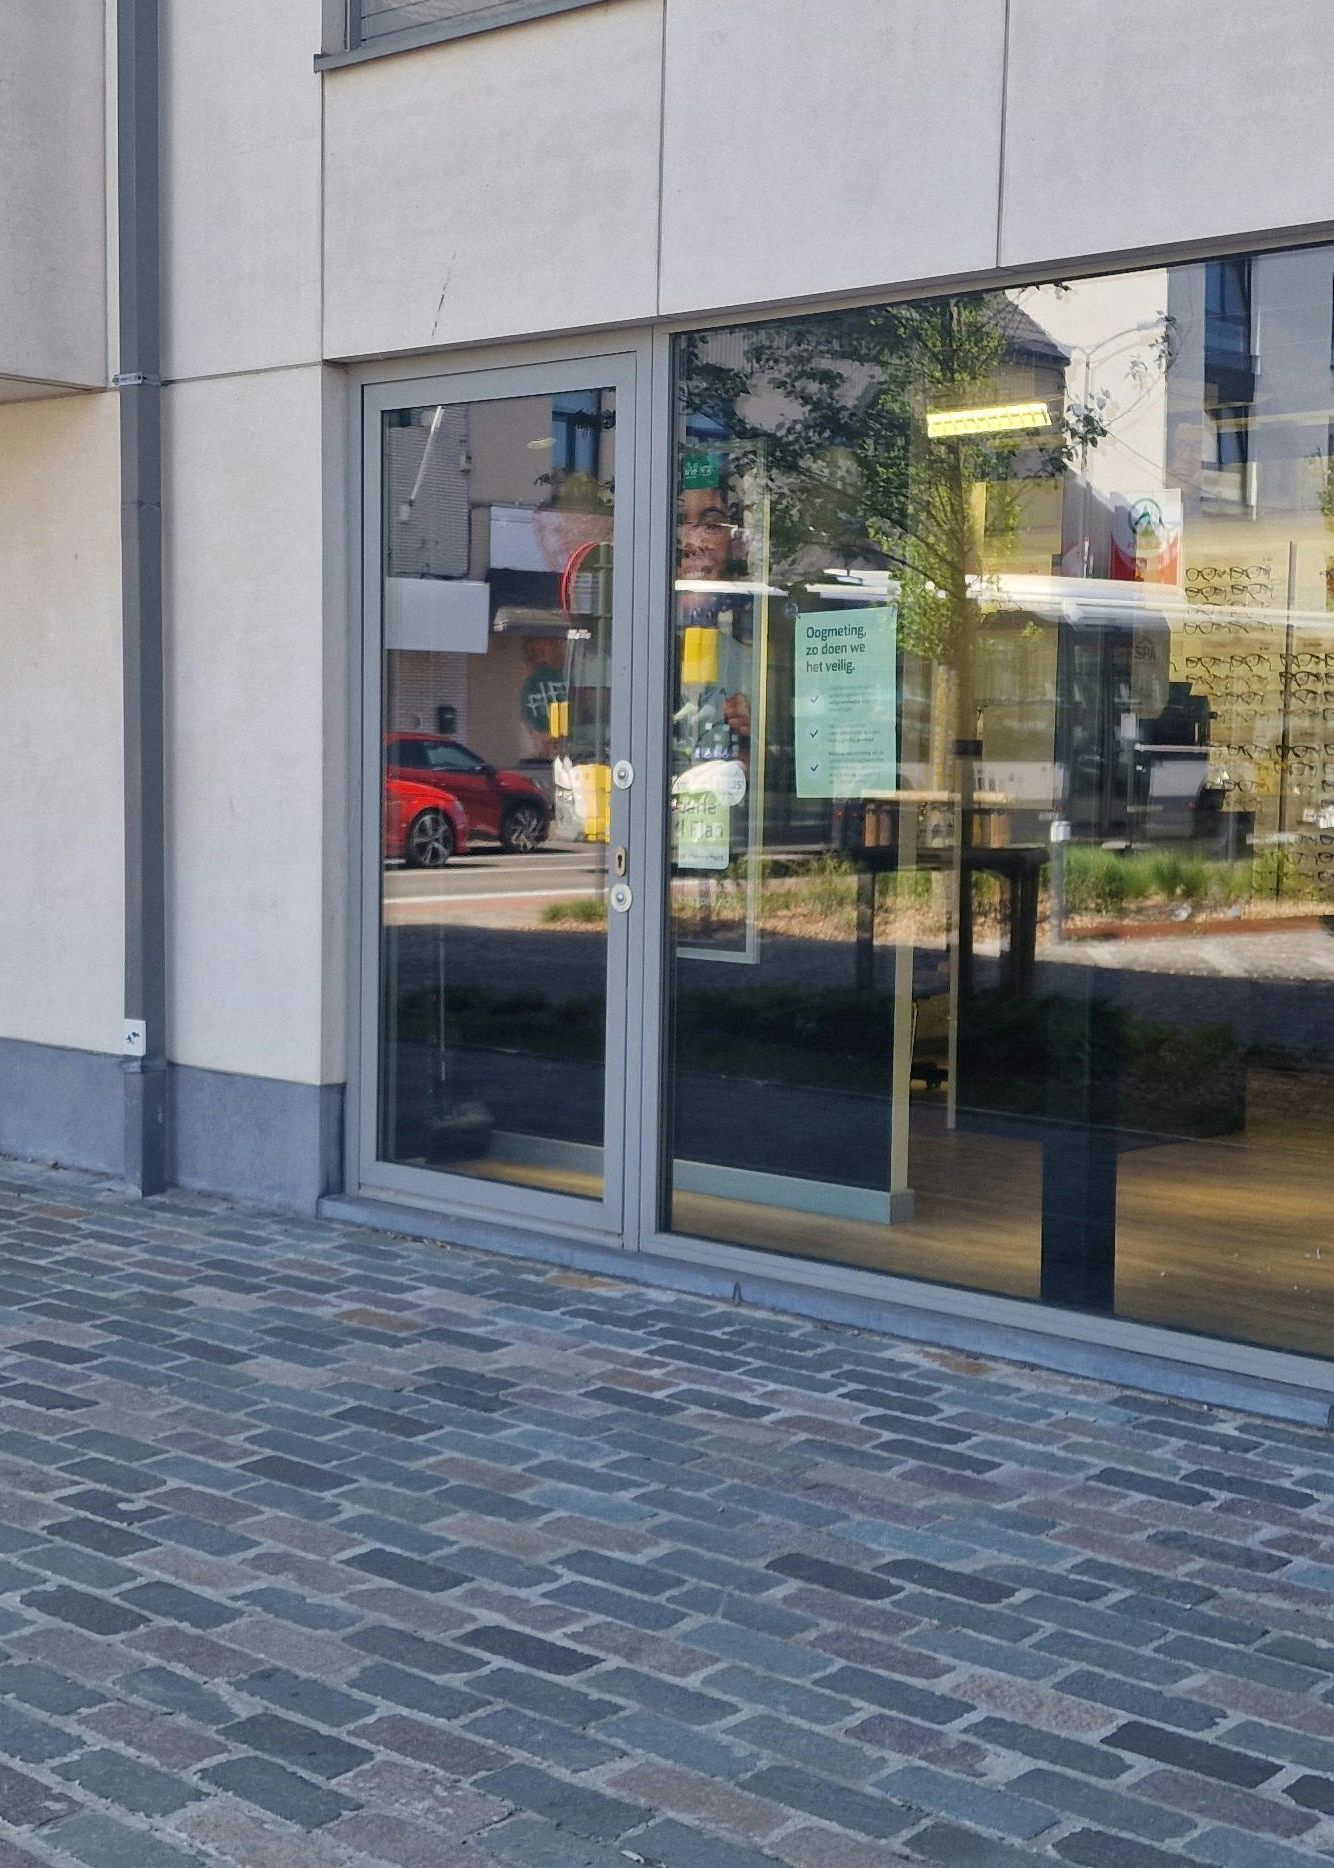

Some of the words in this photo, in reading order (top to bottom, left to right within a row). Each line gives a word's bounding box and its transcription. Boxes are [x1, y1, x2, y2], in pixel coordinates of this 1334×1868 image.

[806, 624, 867, 641] Oogmeting,
[806, 646, 818, 655] zo
[821, 643, 847, 655] doen
[850, 643, 866, 653] we
[806, 660, 823, 673] het
[825, 659, 855, 674] veilig.
